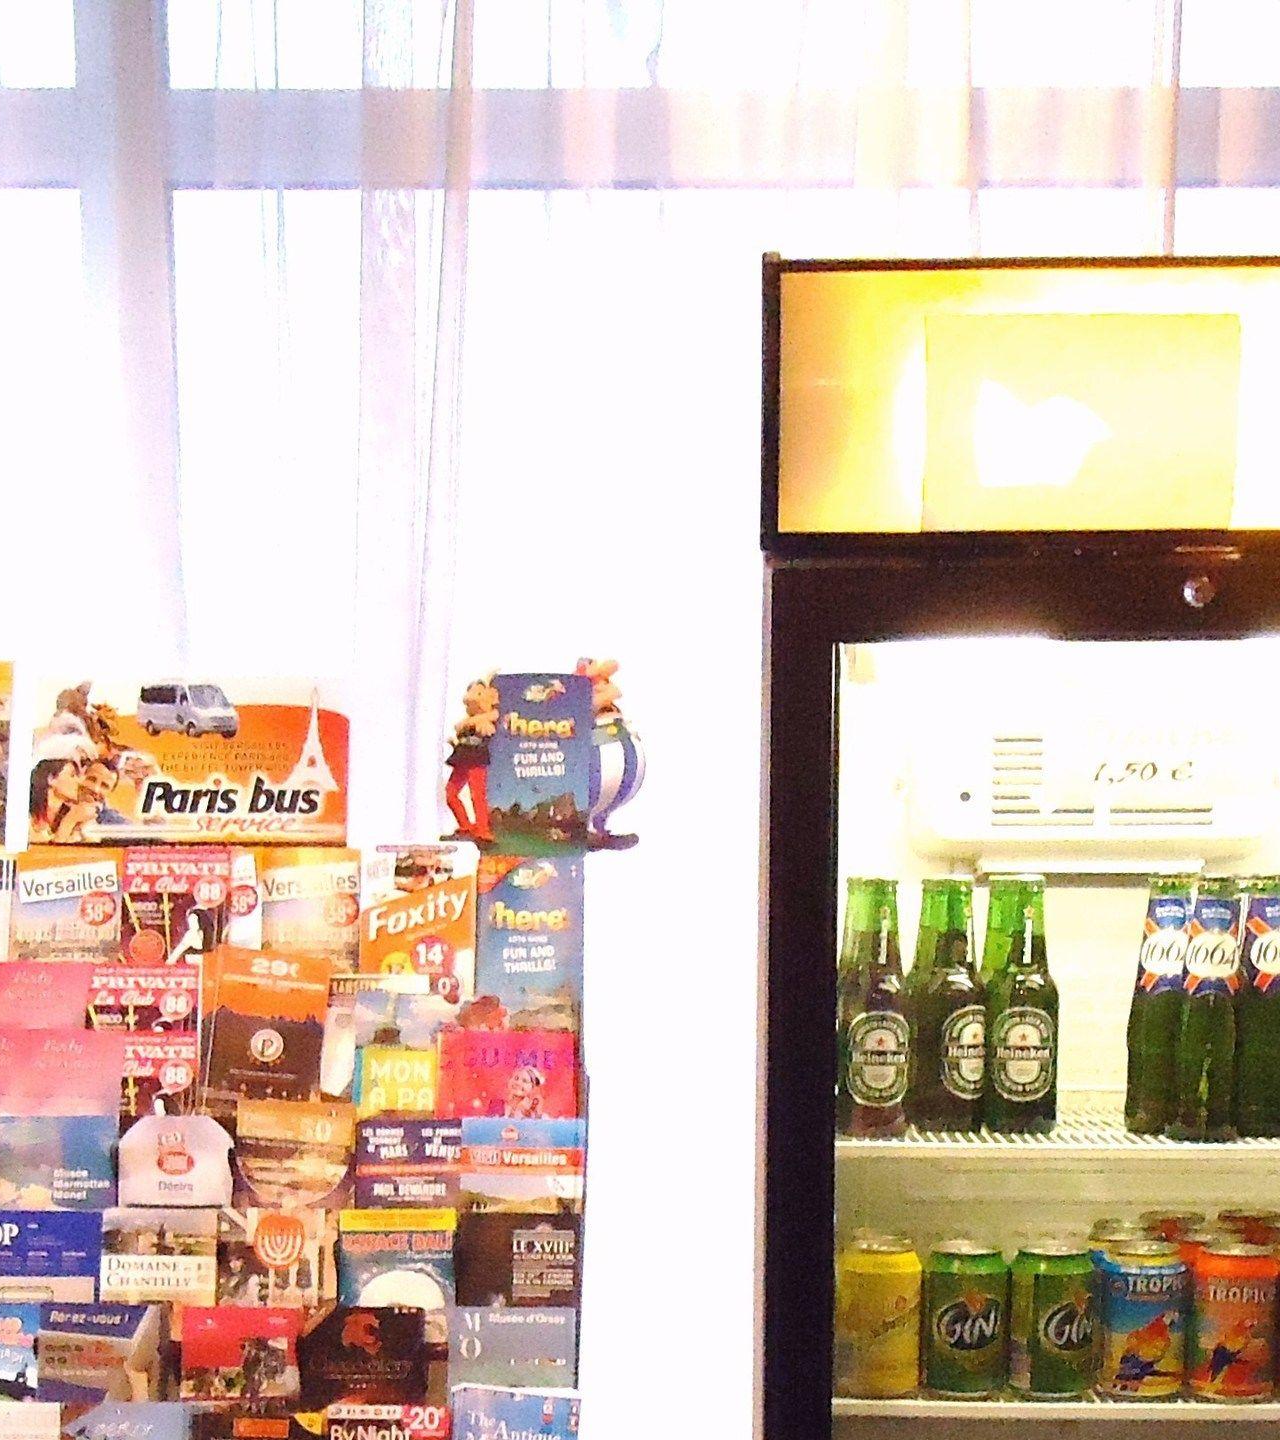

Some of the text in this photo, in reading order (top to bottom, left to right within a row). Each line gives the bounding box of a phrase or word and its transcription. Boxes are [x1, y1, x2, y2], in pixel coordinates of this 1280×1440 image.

[141, 776, 320, 814] Paris bus
[126, 863, 229, 876] PRIVATE
[22, 872, 116, 897] Versailles
[368, 889, 469, 941] Foxity
[1189, 943, 1236, 968] 1664
[92, 976, 196, 989] PRIVATE
[124, 1045, 196, 1059] IVATE
